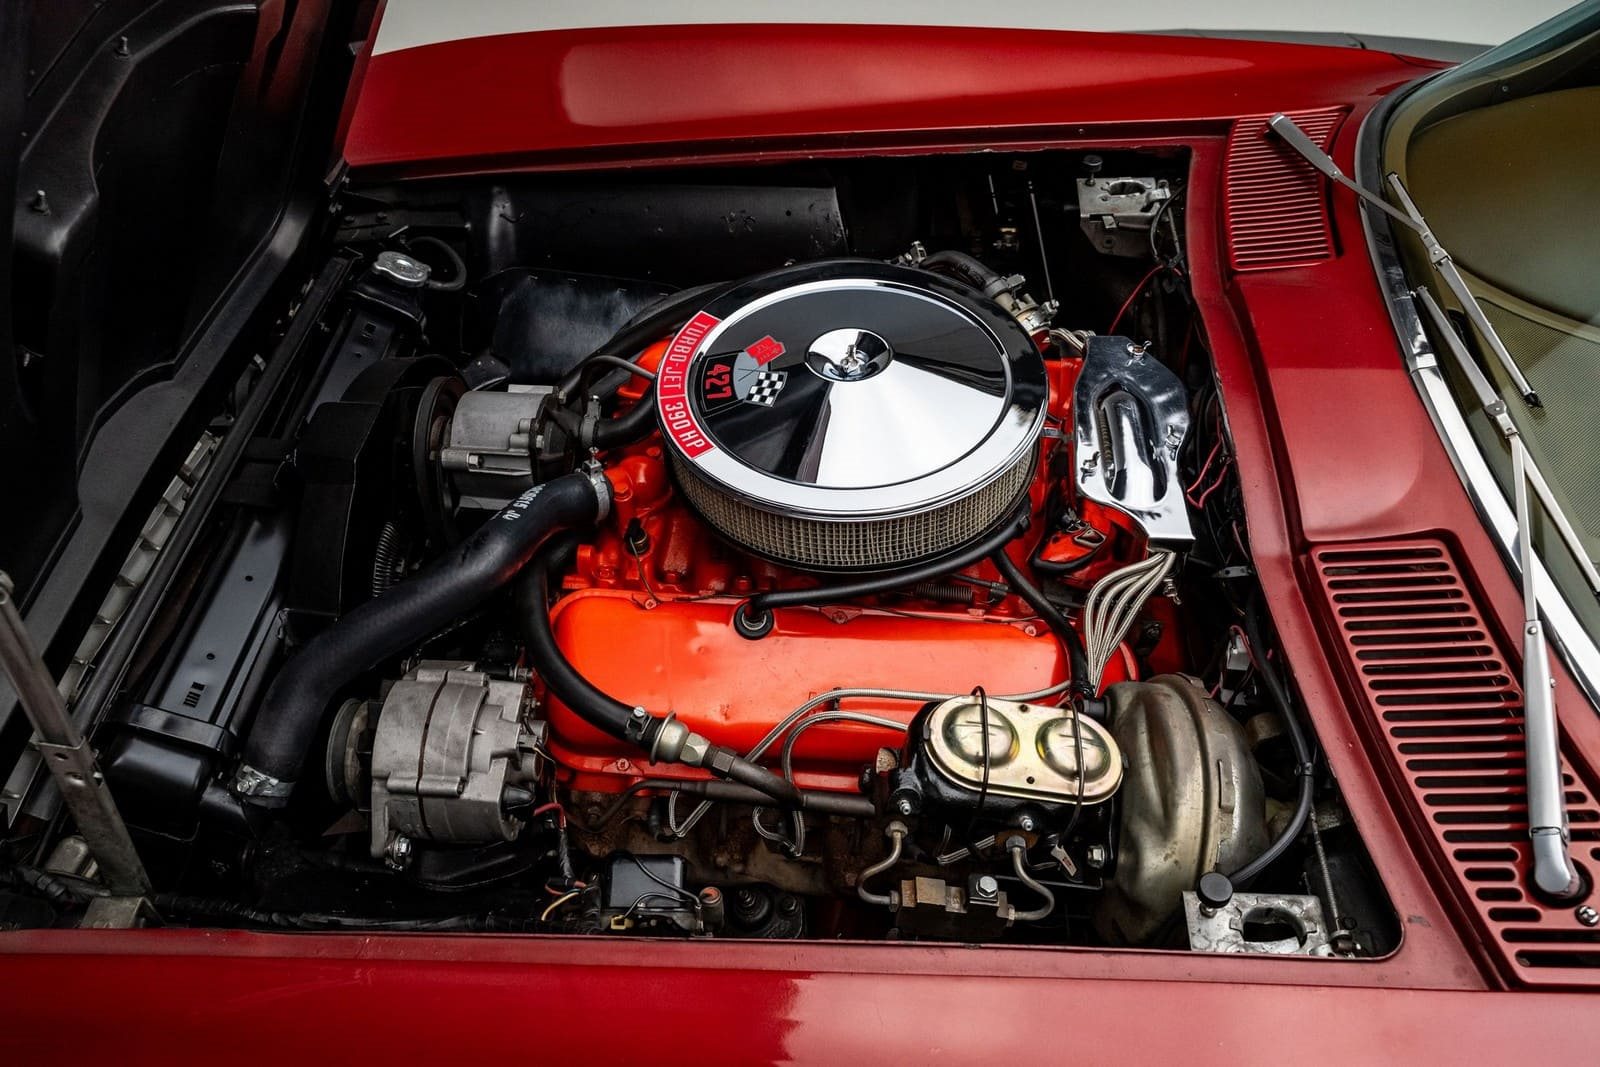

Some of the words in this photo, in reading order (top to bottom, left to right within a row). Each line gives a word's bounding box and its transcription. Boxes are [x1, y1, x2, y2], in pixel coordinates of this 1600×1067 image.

[663, 321, 710, 389] TURBO-JET
[705, 363, 732, 399] 427
[664, 401, 692, 431] 390
[679, 428, 706, 448] HP
